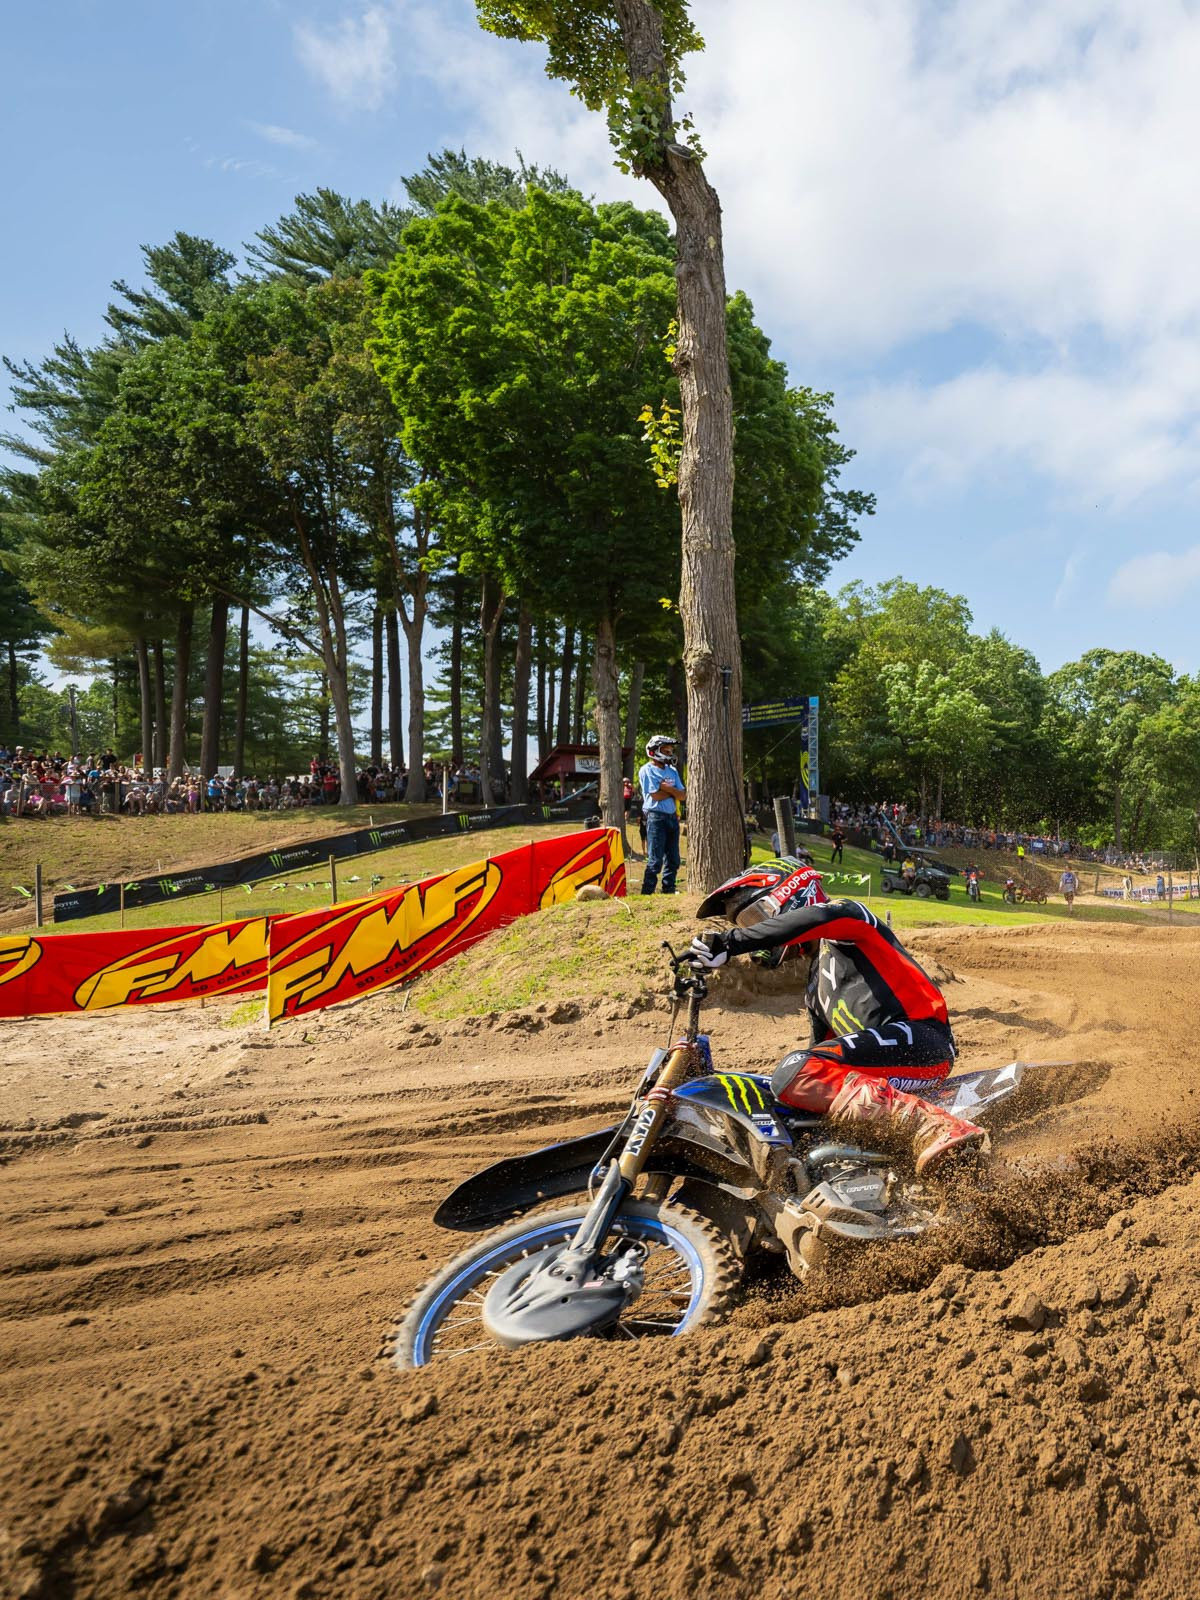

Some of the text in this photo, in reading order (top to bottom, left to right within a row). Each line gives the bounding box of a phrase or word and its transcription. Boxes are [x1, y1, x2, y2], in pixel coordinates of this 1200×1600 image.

[84, 917, 269, 1010] FM
[270, 860, 490, 1023] FMF
[624, 1109, 656, 1156] KYB
